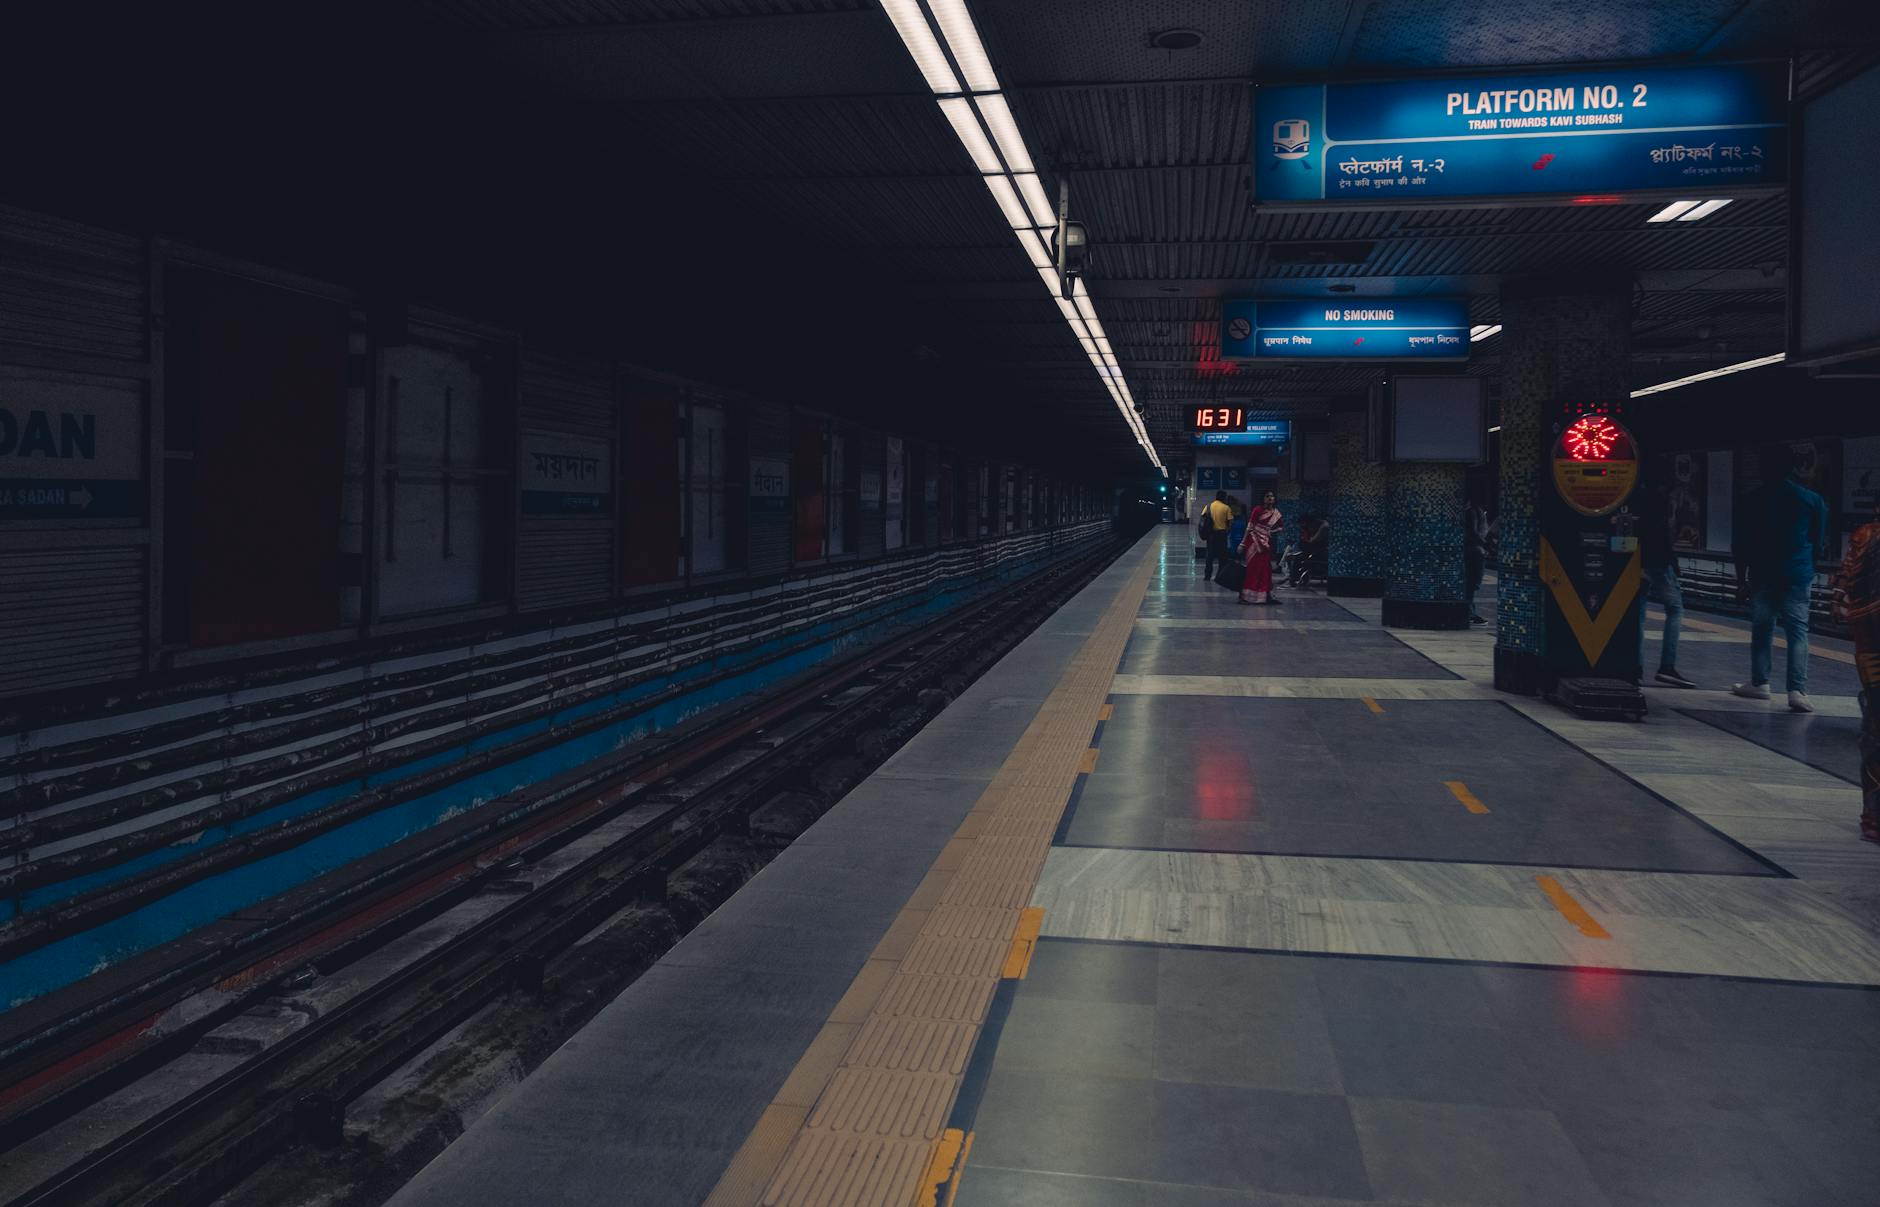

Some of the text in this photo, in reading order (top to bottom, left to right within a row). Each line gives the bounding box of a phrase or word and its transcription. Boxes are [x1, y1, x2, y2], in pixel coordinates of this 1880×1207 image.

[1446, 83, 1648, 116] PLATFORM NO. 2
[1468, 113, 1623, 130] TRAIN TOWARDS KAVI SUBHASH
[1339, 155, 1403, 174] प्लेटफॉर्म
[1325, 309, 1395, 321] NO SMOKING
[530, 451, 600, 481] ময়দান
[16, 488, 65, 505] SADAN
